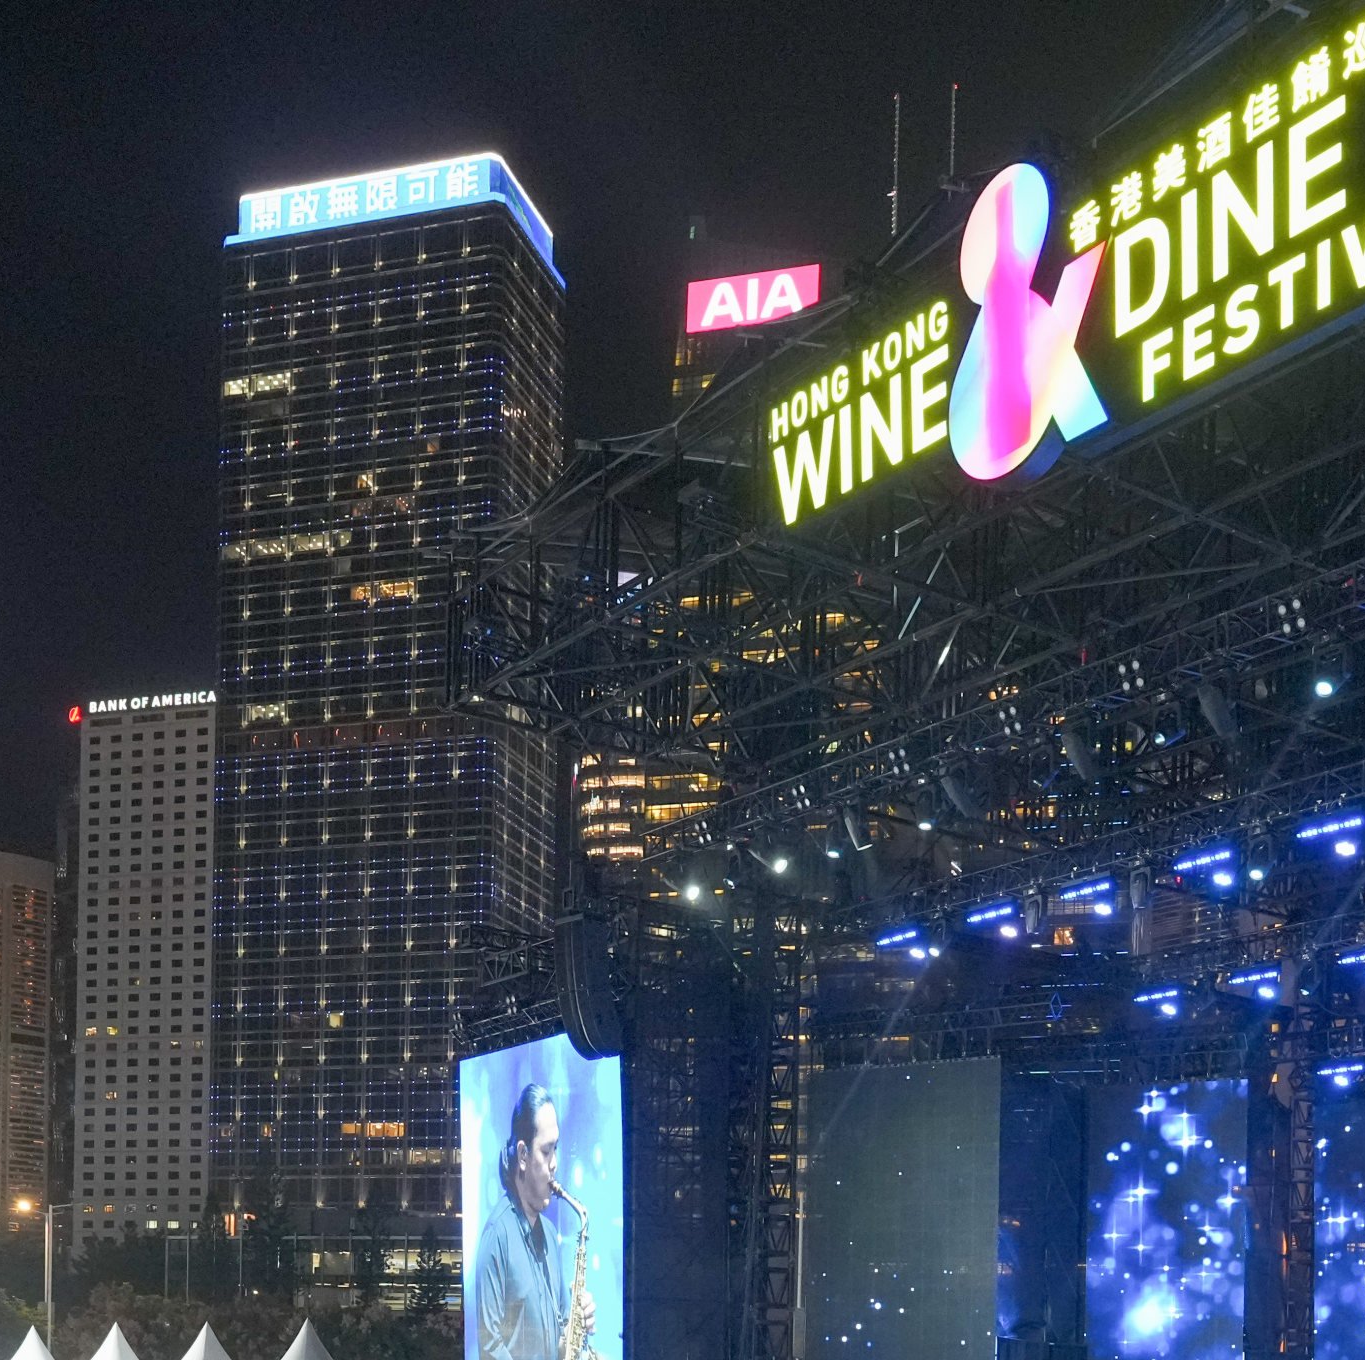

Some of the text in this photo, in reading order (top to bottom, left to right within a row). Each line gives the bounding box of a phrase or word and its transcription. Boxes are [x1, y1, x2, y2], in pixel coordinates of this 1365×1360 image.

[700, 273, 803, 327] AIA
[772, 344, 949, 525] WINE
[1114, 94, 1346, 338] DINE
[771, 302, 948, 442] HONG KONG
[89, 691, 216, 713] BANK OF AMERICA
